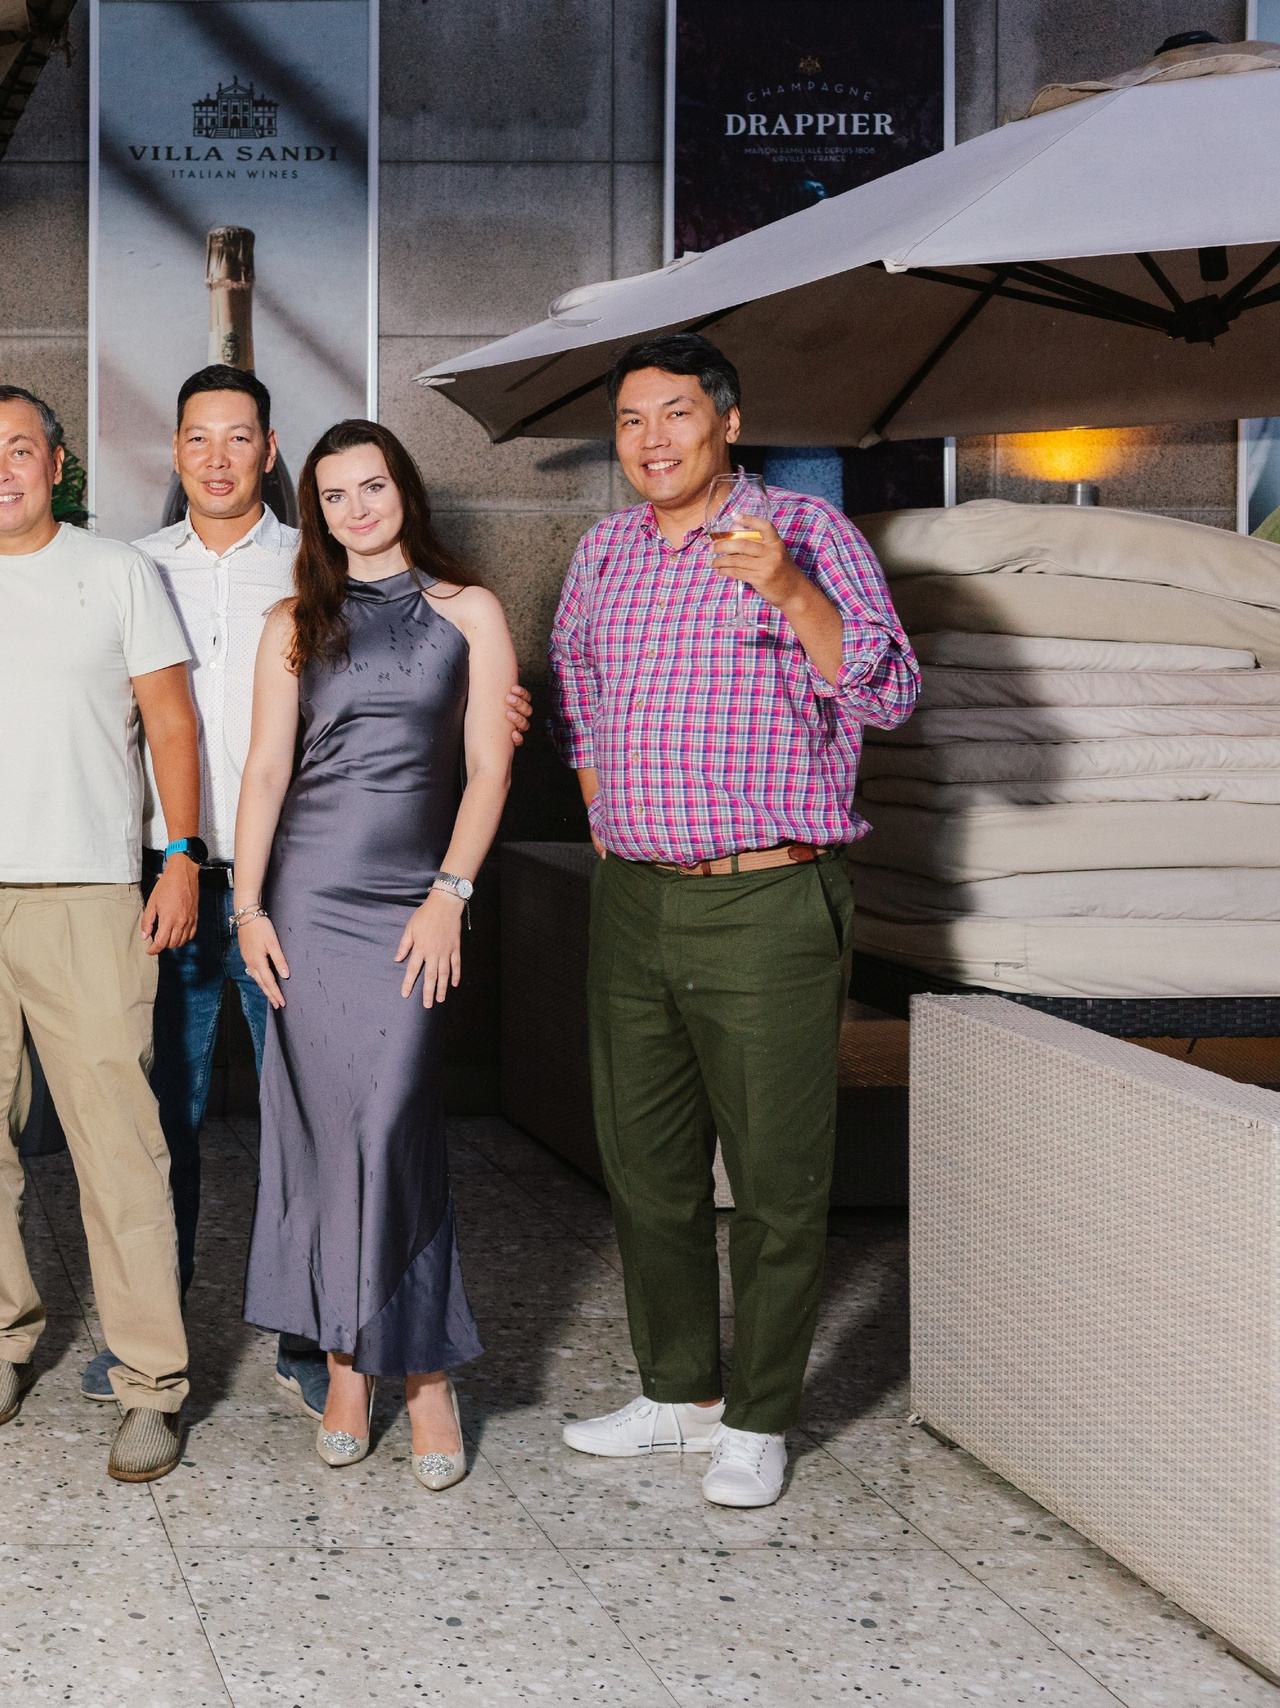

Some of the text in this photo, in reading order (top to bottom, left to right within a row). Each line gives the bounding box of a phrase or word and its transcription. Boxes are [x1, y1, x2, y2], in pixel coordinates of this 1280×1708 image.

[746, 80, 872, 102] CHAMPAGNE
[724, 113, 894, 136] DRAPPIER
[128, 145, 338, 161] VILLA SANDI
[813, 155, 846, 163] FRANCE
[171, 169, 299, 179] ITALIAN WINES
